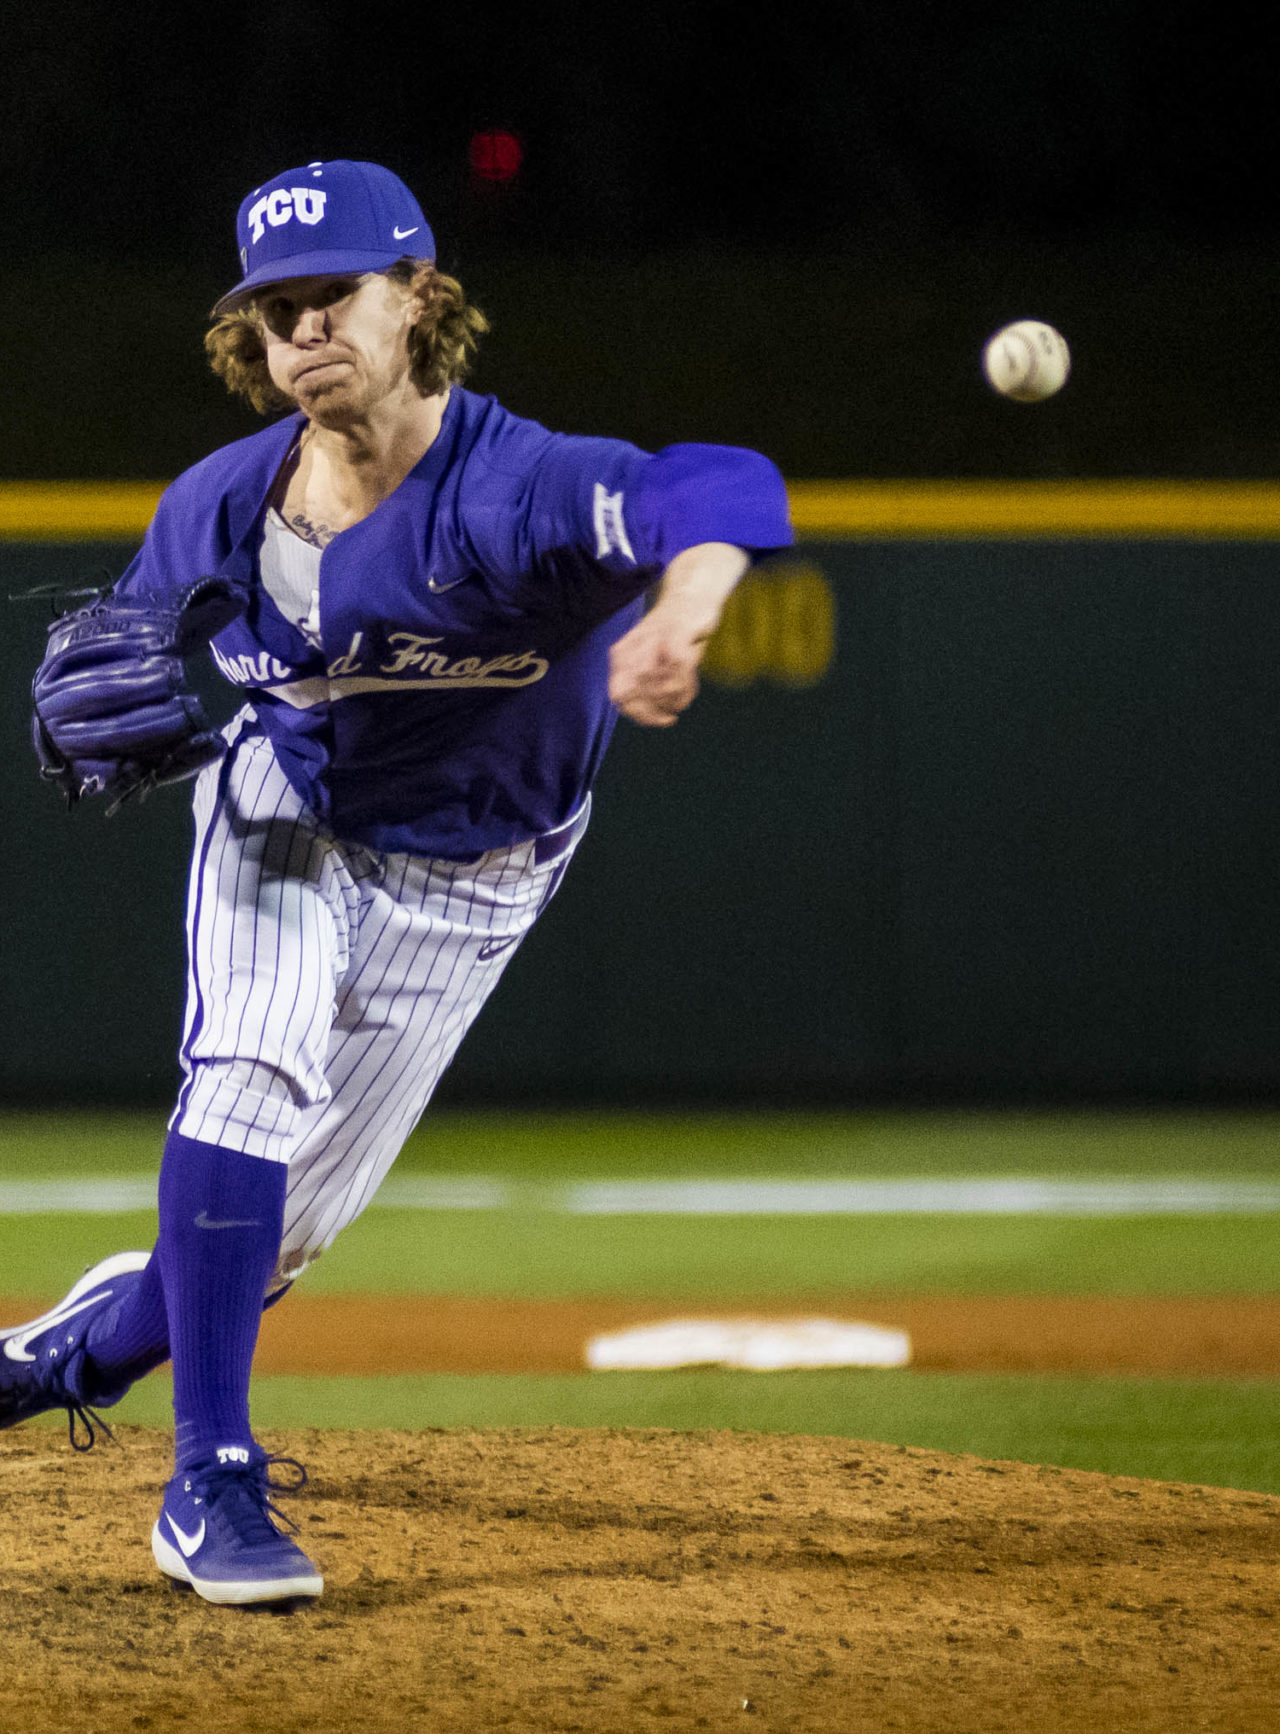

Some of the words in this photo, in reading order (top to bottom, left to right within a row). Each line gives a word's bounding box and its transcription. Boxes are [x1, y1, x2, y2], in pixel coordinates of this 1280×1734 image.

[248, 187, 327, 245] TCU
[209, 632, 363, 685] Hornd
[380, 632, 540, 680] Frogs
